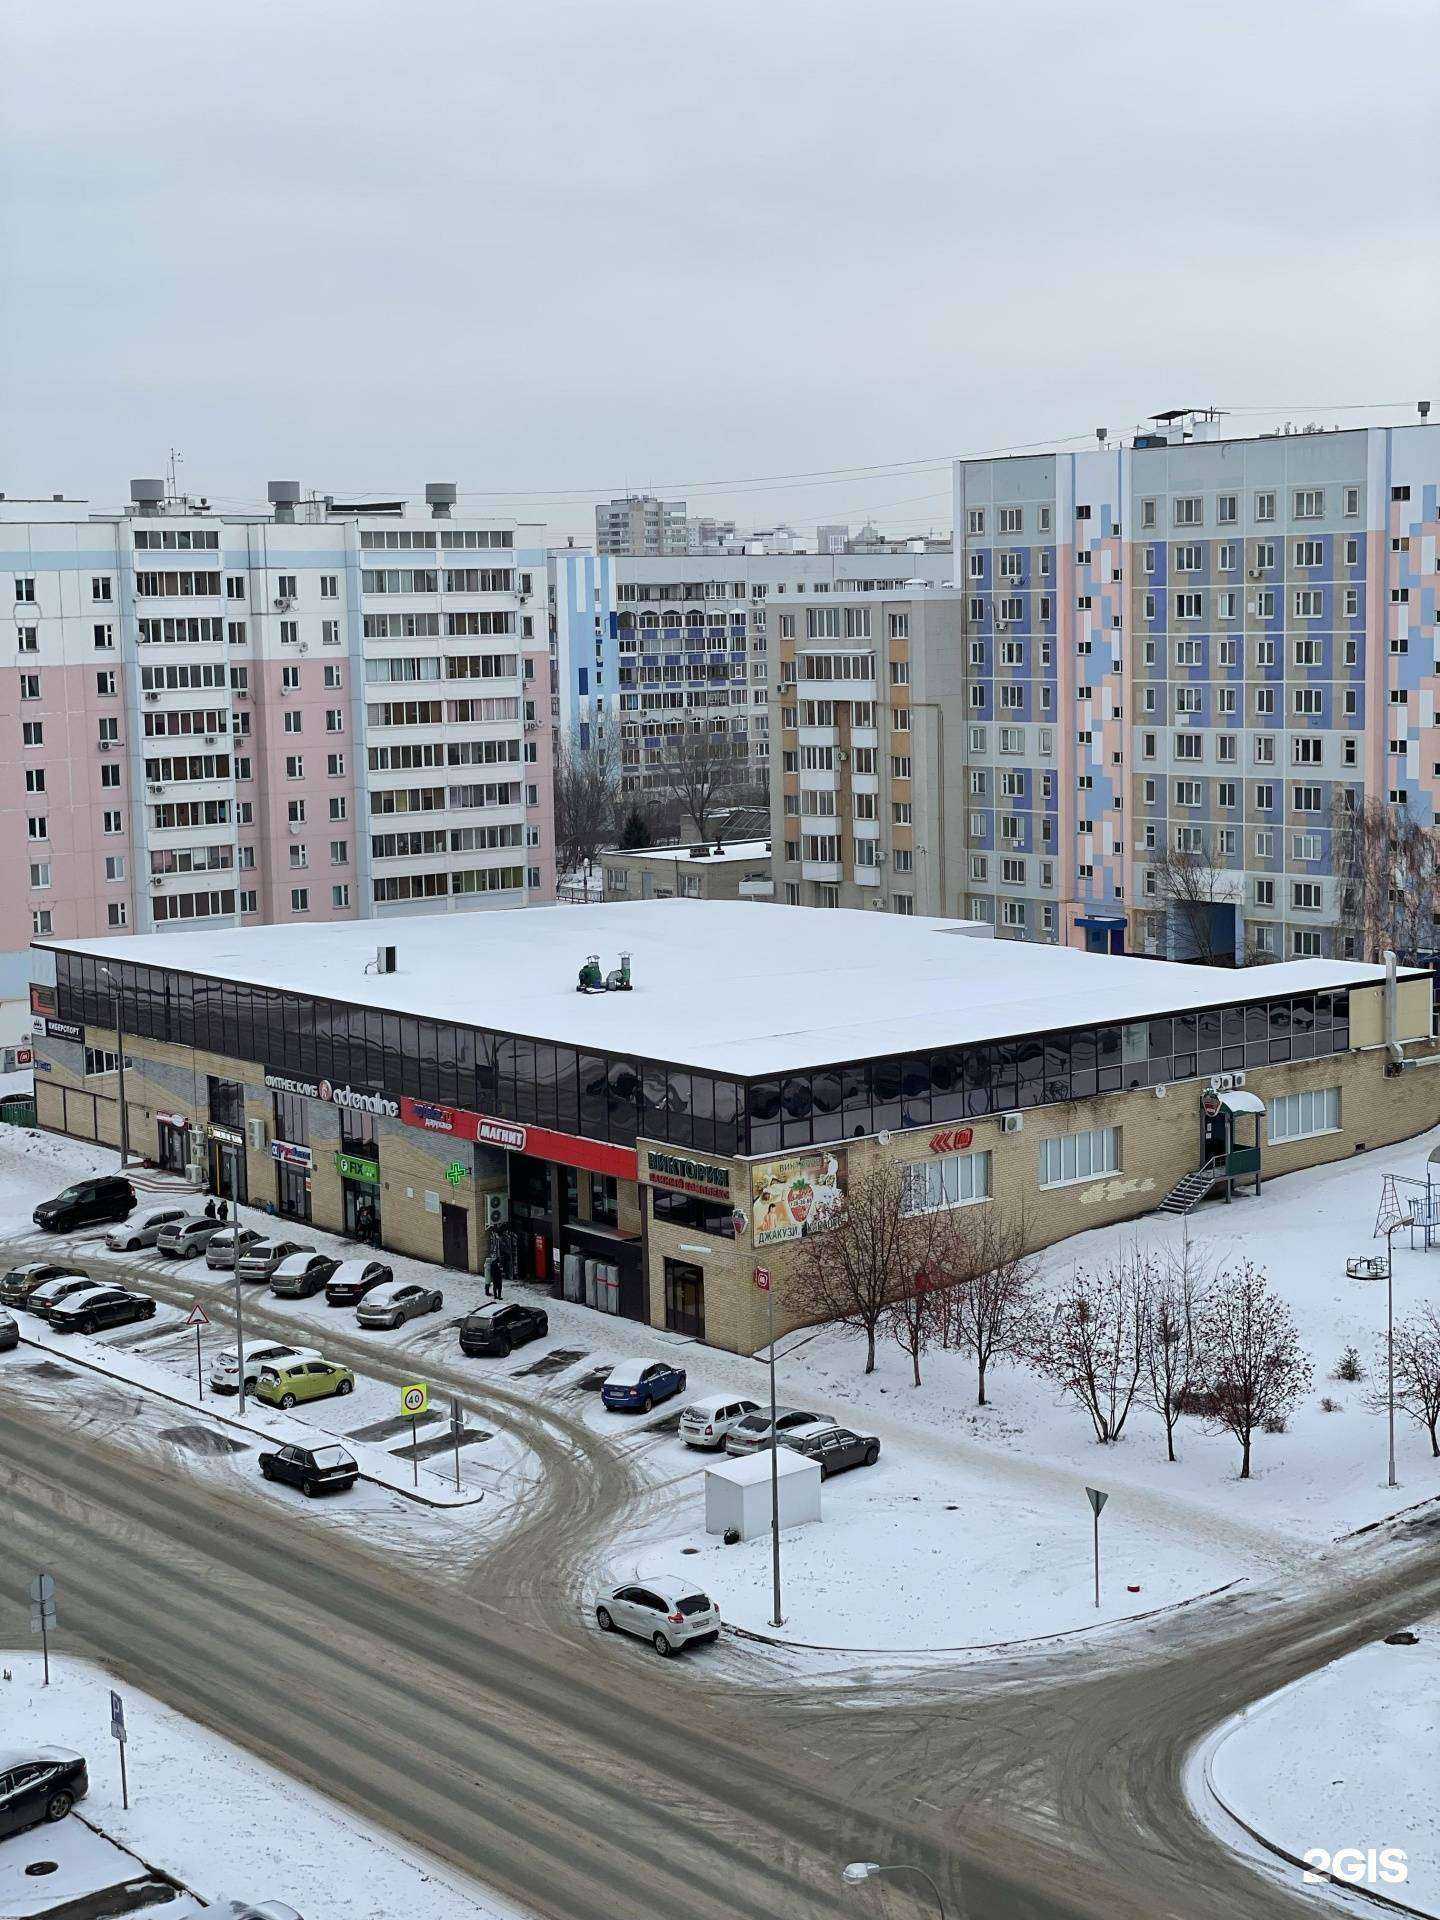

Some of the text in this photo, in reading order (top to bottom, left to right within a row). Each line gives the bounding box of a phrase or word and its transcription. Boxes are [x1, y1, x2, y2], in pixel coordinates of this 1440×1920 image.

[333, 1084, 398, 1117] adrenaline
[481, 1124, 523, 1146] МАГНИТ
[350, 1162, 364, 1176] FIX
[648, 1151, 730, 1187] ВИКТОРИЯ
[408, 1394, 420, 1404] 40
